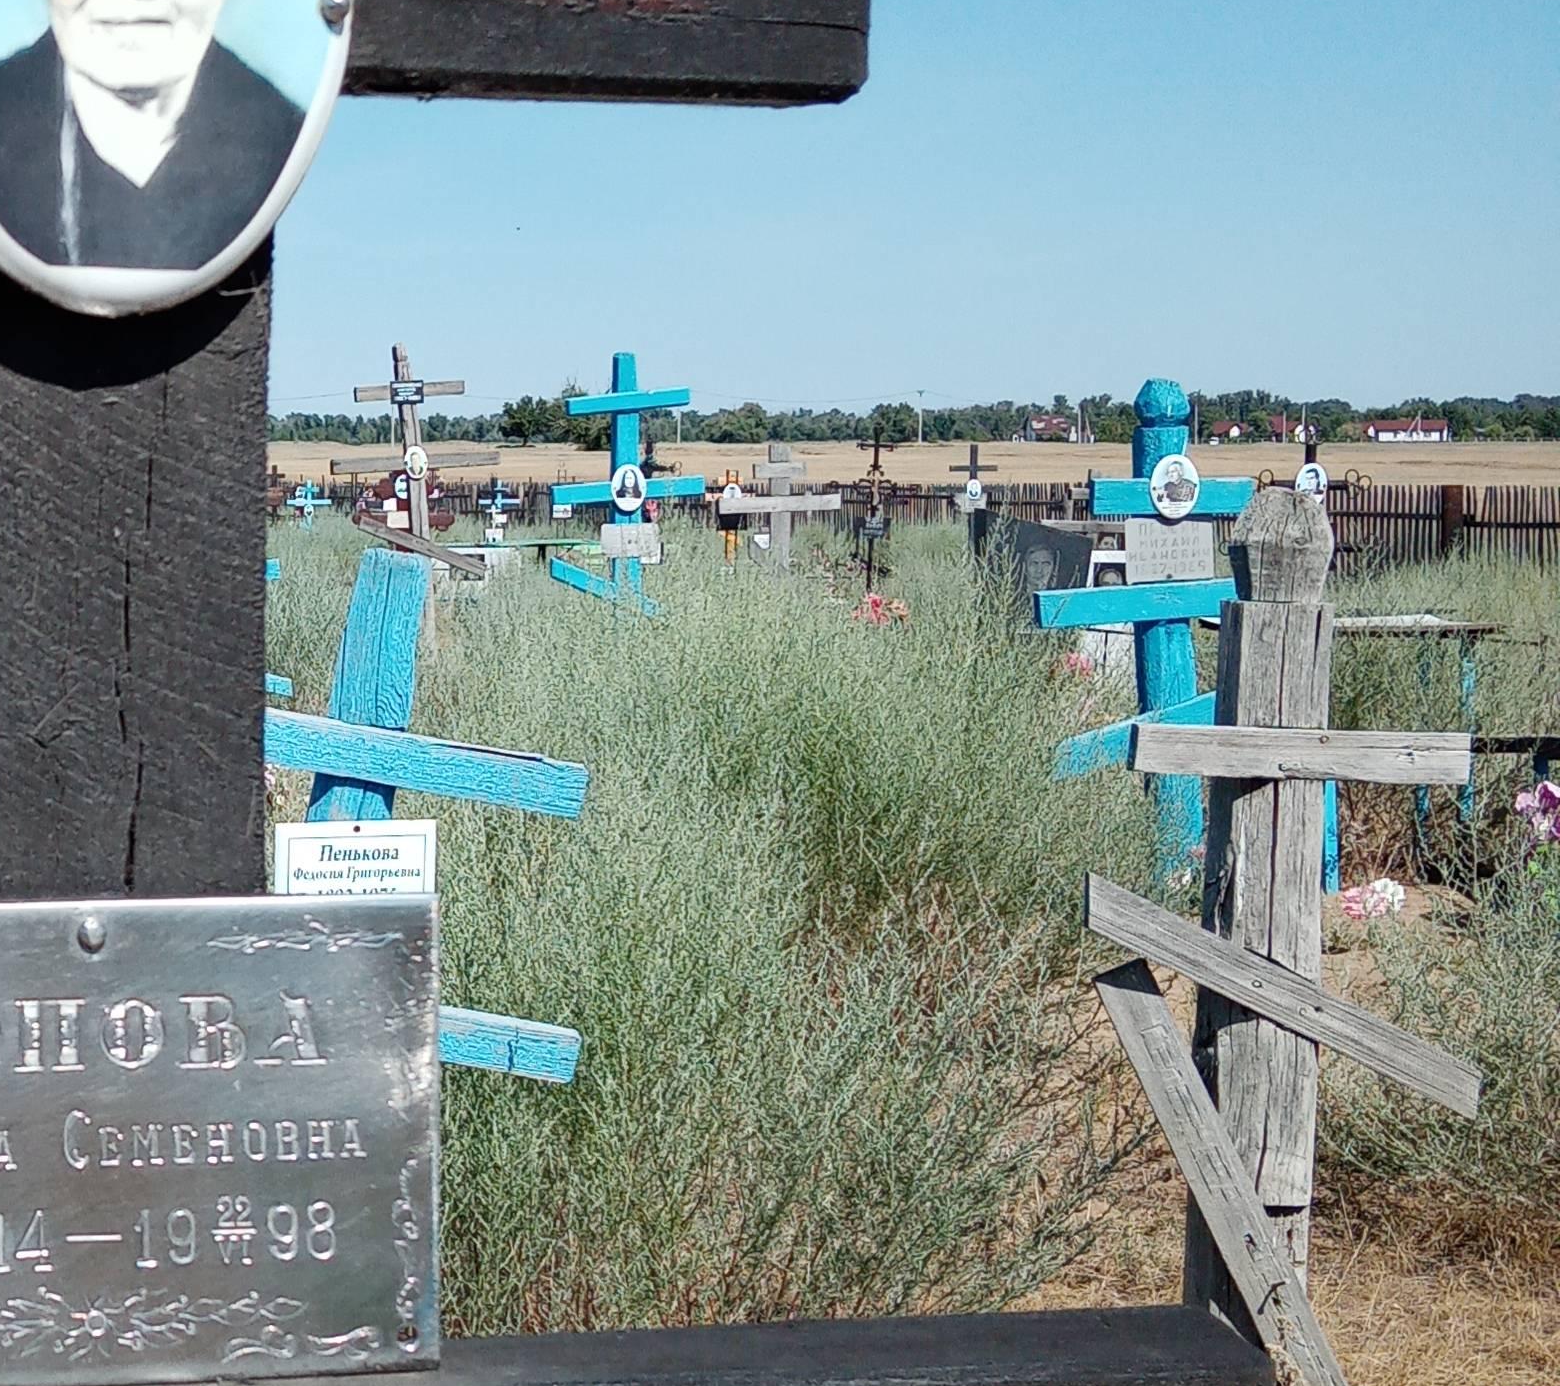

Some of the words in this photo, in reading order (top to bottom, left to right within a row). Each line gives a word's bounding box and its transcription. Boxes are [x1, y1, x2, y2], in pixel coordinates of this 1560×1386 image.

[319, 844, 399, 862] Пенькова
[346, 865, 421, 882] Григорьевна
[134, 1208, 197, 1268] 19
[267, 1199, 337, 1261] 98
